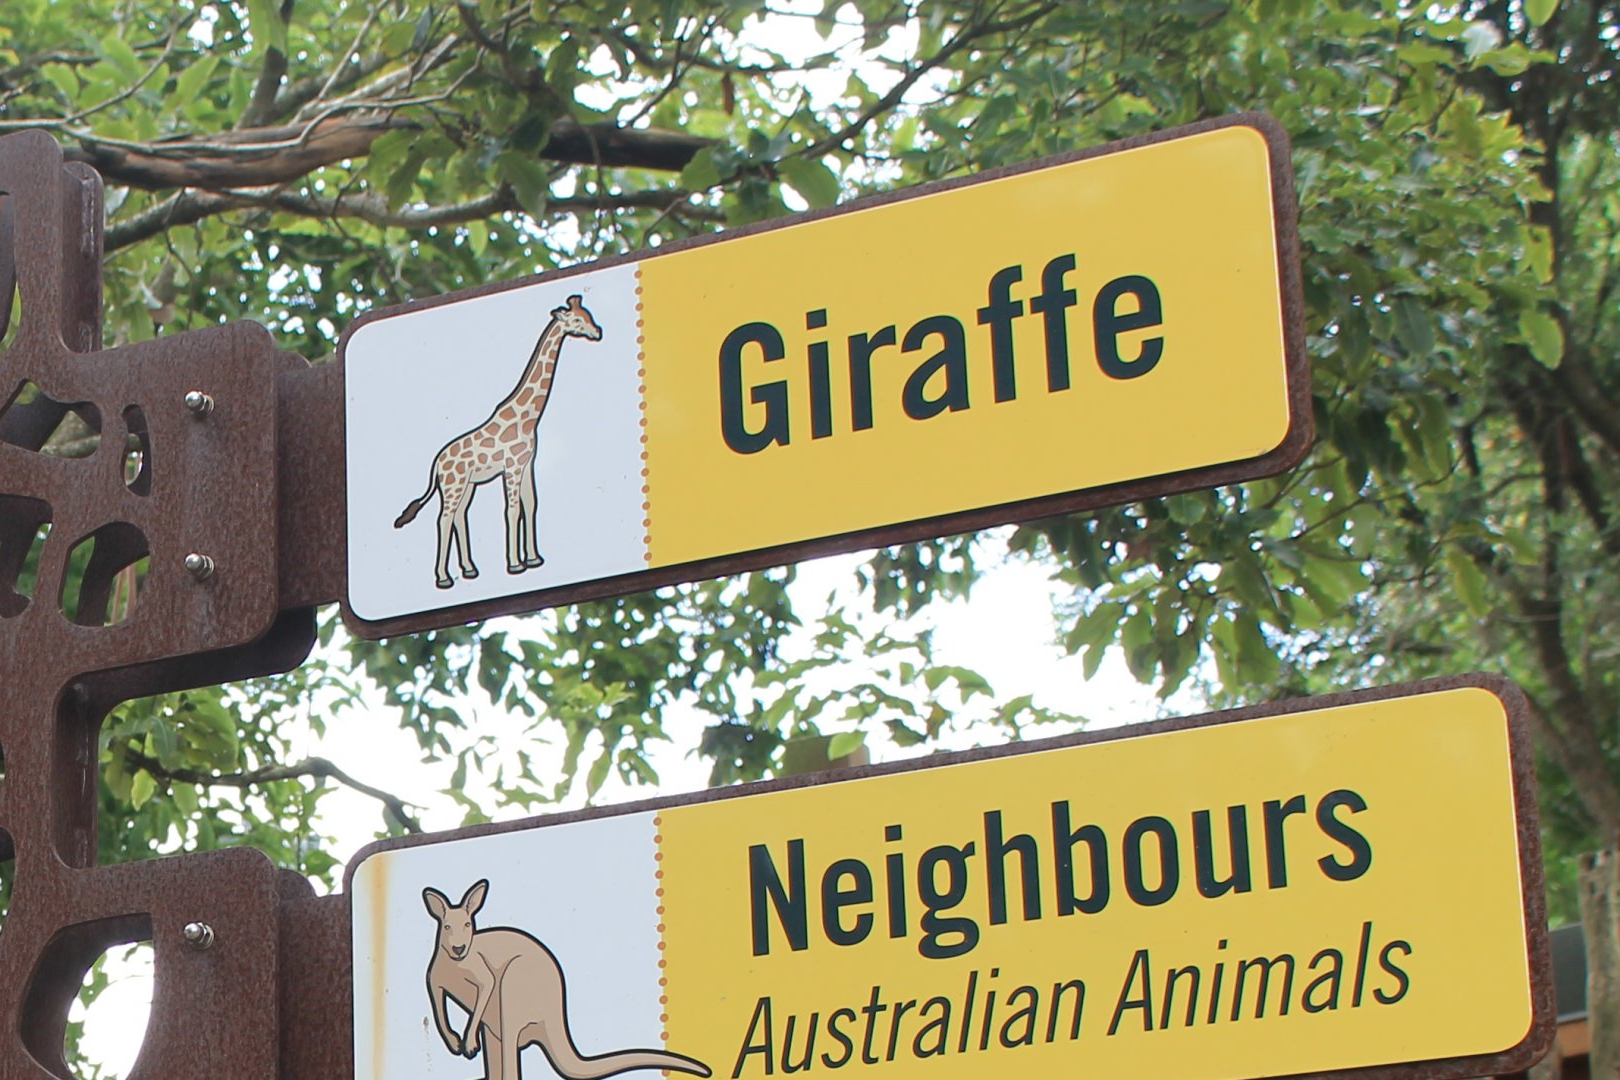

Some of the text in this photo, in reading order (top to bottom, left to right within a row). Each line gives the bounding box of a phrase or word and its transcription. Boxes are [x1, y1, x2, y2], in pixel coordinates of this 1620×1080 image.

[719, 253, 1164, 455] Giraffe
[748, 788, 1372, 960] Neighbours
[731, 921, 1412, 1080] Australian Animals
